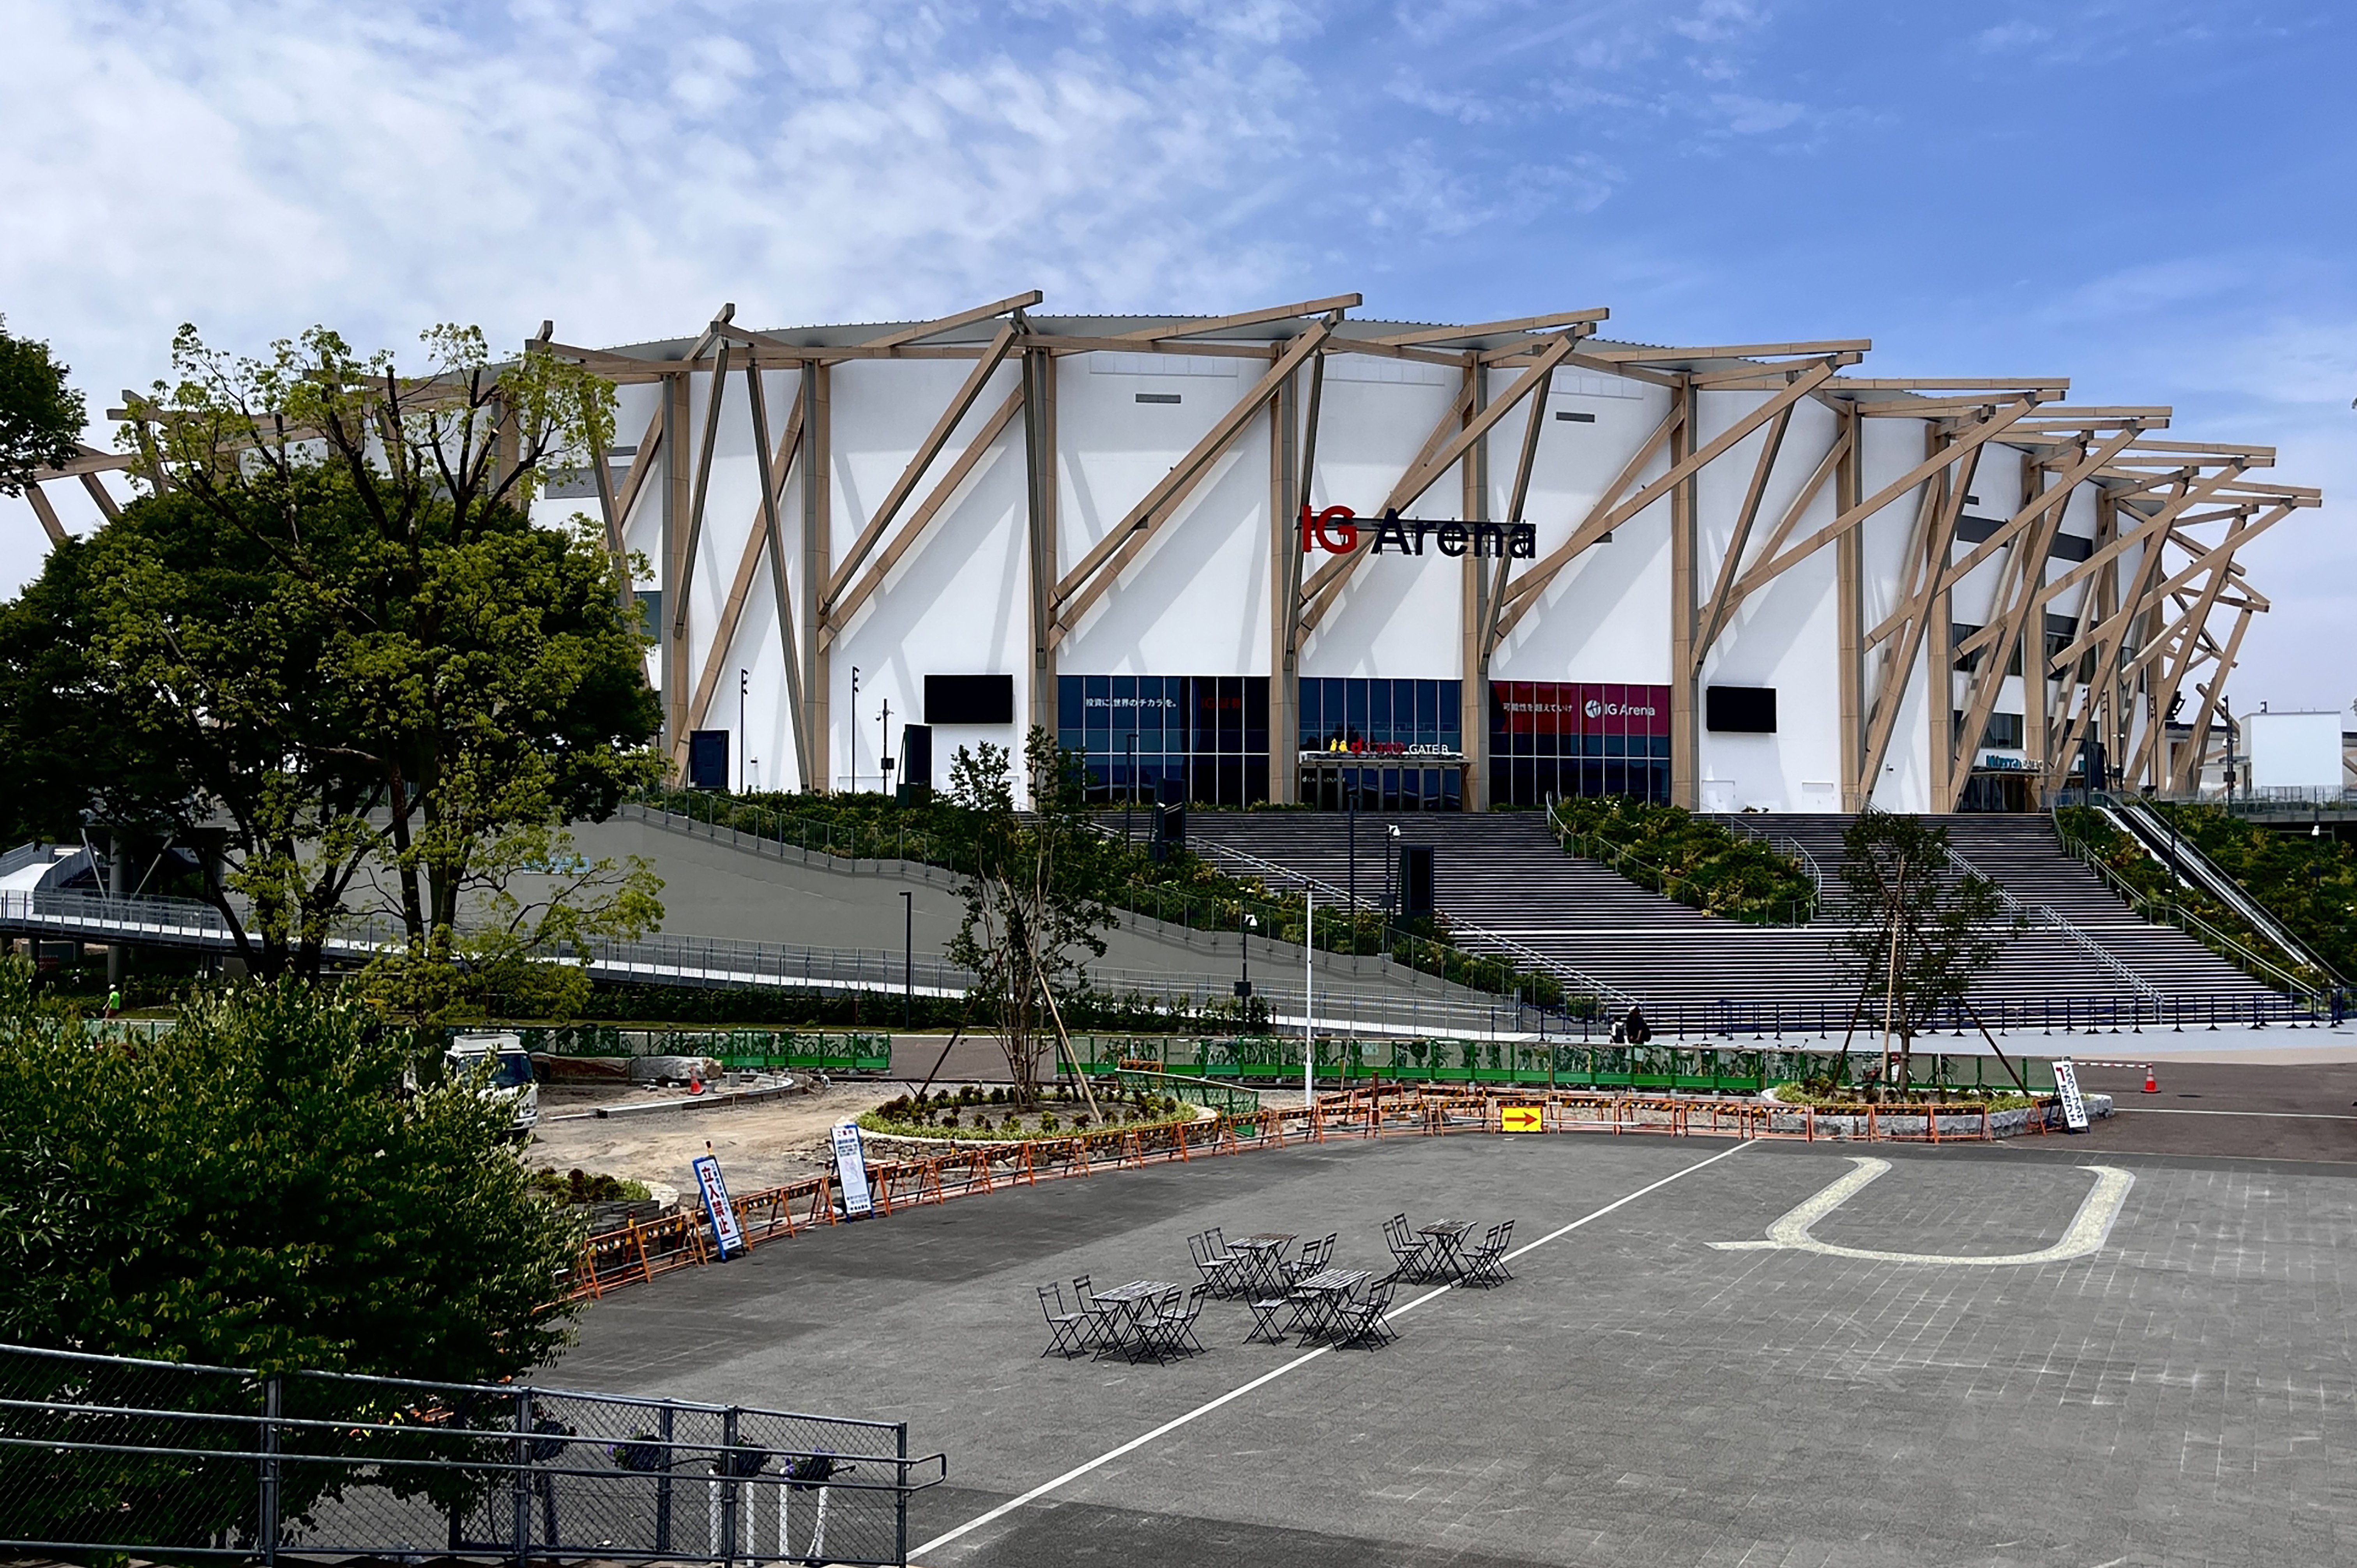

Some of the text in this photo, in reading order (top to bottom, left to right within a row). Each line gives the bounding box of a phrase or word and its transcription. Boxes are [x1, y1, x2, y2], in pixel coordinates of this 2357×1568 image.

[1302, 504, 1536, 558] IG Arena
[1605, 703, 1656, 716] IG Arena
[1409, 744, 1438, 754] GATE
[701, 1166, 731, 1235] 立入禁止
